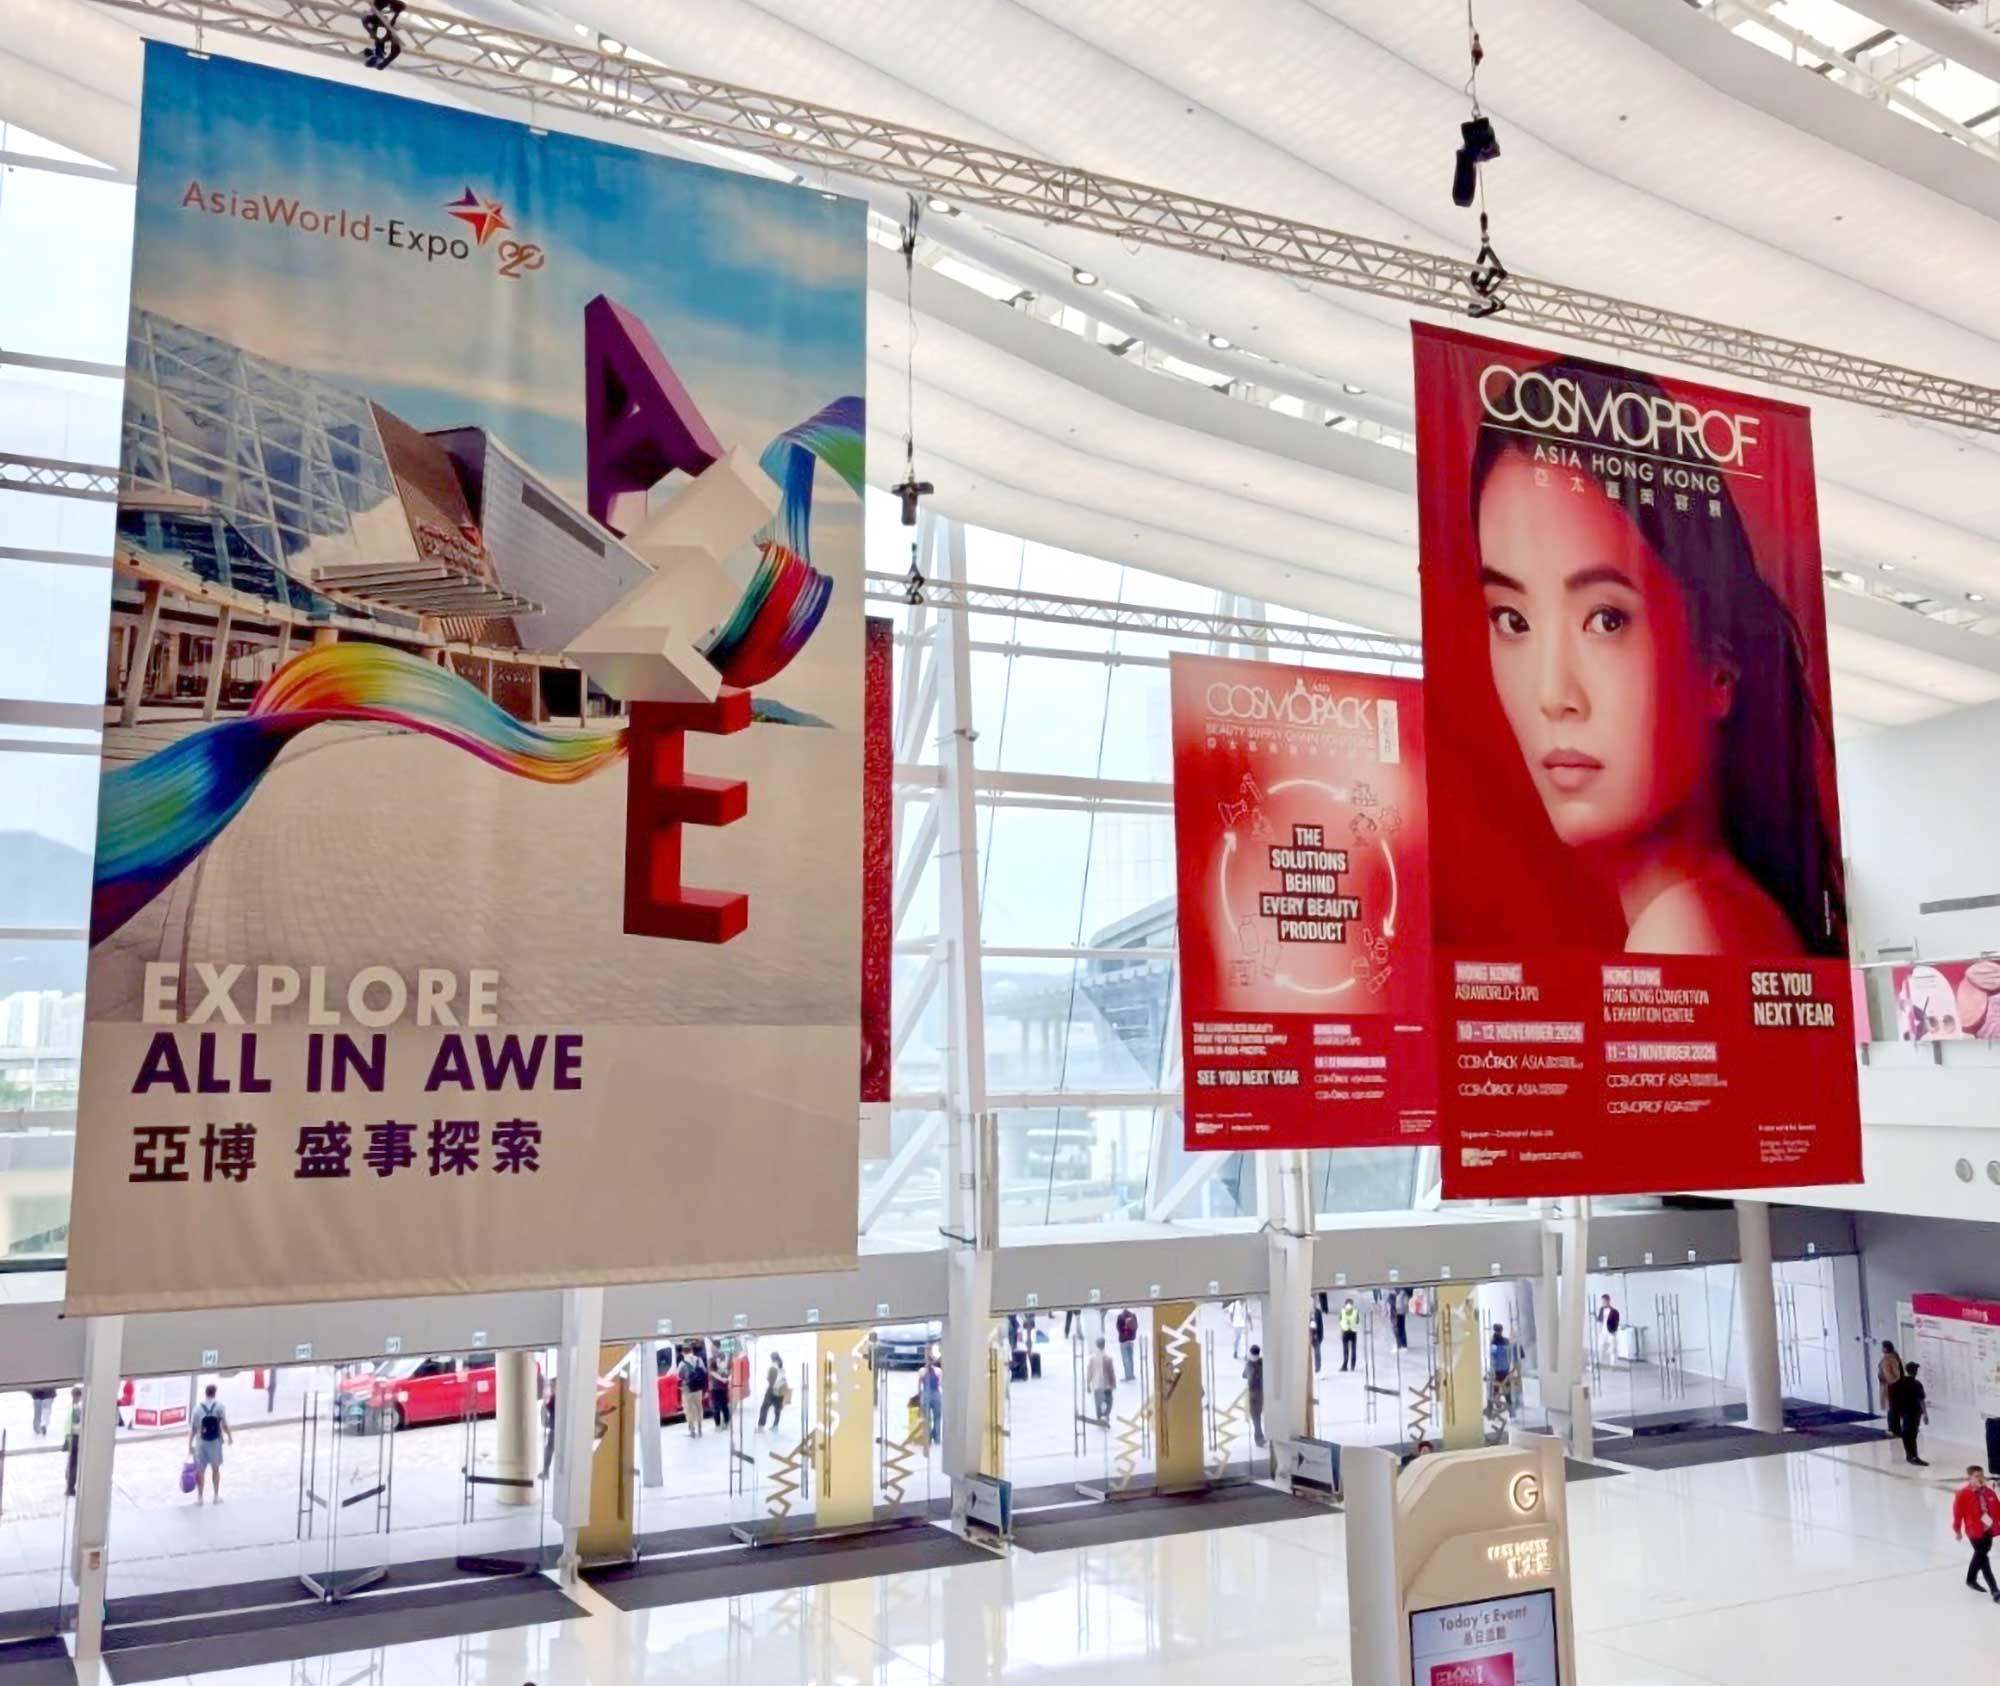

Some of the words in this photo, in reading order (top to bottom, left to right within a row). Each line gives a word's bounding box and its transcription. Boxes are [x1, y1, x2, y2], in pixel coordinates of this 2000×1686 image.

[182, 180, 469, 262] AsiaWorld-Expo
[1479, 365, 1760, 466] COSMOPROF
[1534, 444, 1582, 469] ASIA
[1592, 453, 1654, 482] HONG
[1662, 467, 1721, 494] KONG
[1206, 680, 1374, 731] COSMOPACK
[1295, 828, 1322, 846] THE
[1271, 849, 1346, 871] SOLUTIONS
[1285, 873, 1336, 894] BEHIND
[1262, 896, 1304, 916] EVERY
[1307, 897, 1359, 919] BEAUTY
[1280, 920, 1343, 941] PRODUCT
[142, 961, 500, 1028] EXPLORE
[1751, 971, 1779, 995] SEE
[1780, 972, 1812, 996] YOU
[1753, 1002, 1792, 1026] NEXT
[1795, 1003, 1835, 1027] YEAR
[131, 1031, 272, 1094] ALL
[306, 1033, 387, 1093] IN
[424, 1033, 584, 1093] AWE
[1197, 1069, 1216, 1085] SEE
[1218, 1069, 1240, 1086] YOU
[1242, 1069, 1269, 1085] NEXT
[1271, 1069, 1299, 1086] YEAR
[128, 1122, 258, 1183] 亞博
[293, 1118, 543, 1179] 盛事探索
[1512, 1474, 1540, 1512] G
[1439, 1612, 1489, 1633] Today's
[1493, 1605, 1527, 1622] Event
